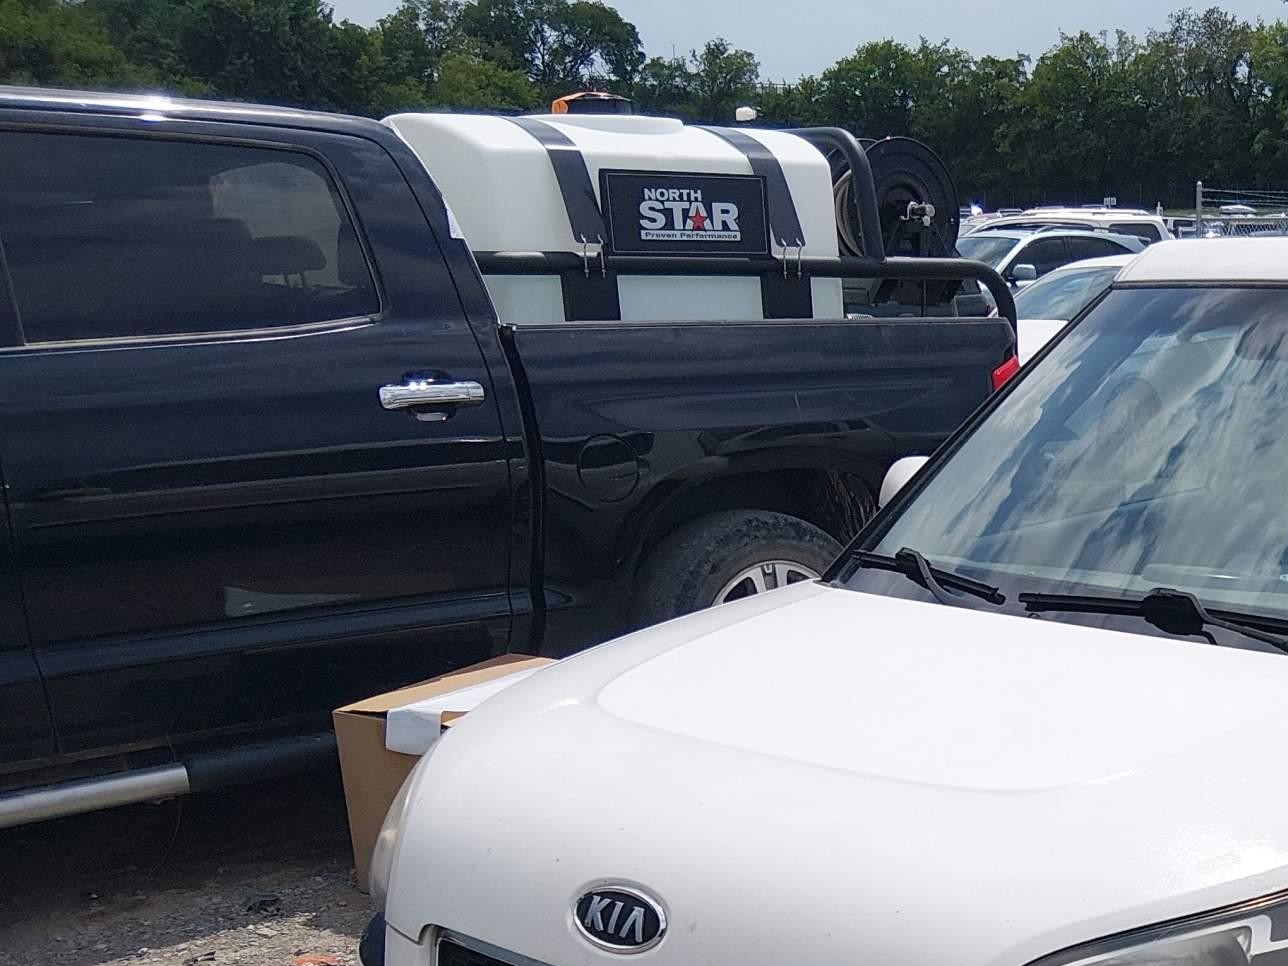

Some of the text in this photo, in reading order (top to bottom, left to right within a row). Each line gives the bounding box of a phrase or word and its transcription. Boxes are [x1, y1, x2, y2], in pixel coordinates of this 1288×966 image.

[643, 188, 702, 201] NORTH
[639, 200, 740, 231] STAR
[584, 895, 645, 943] KIA
